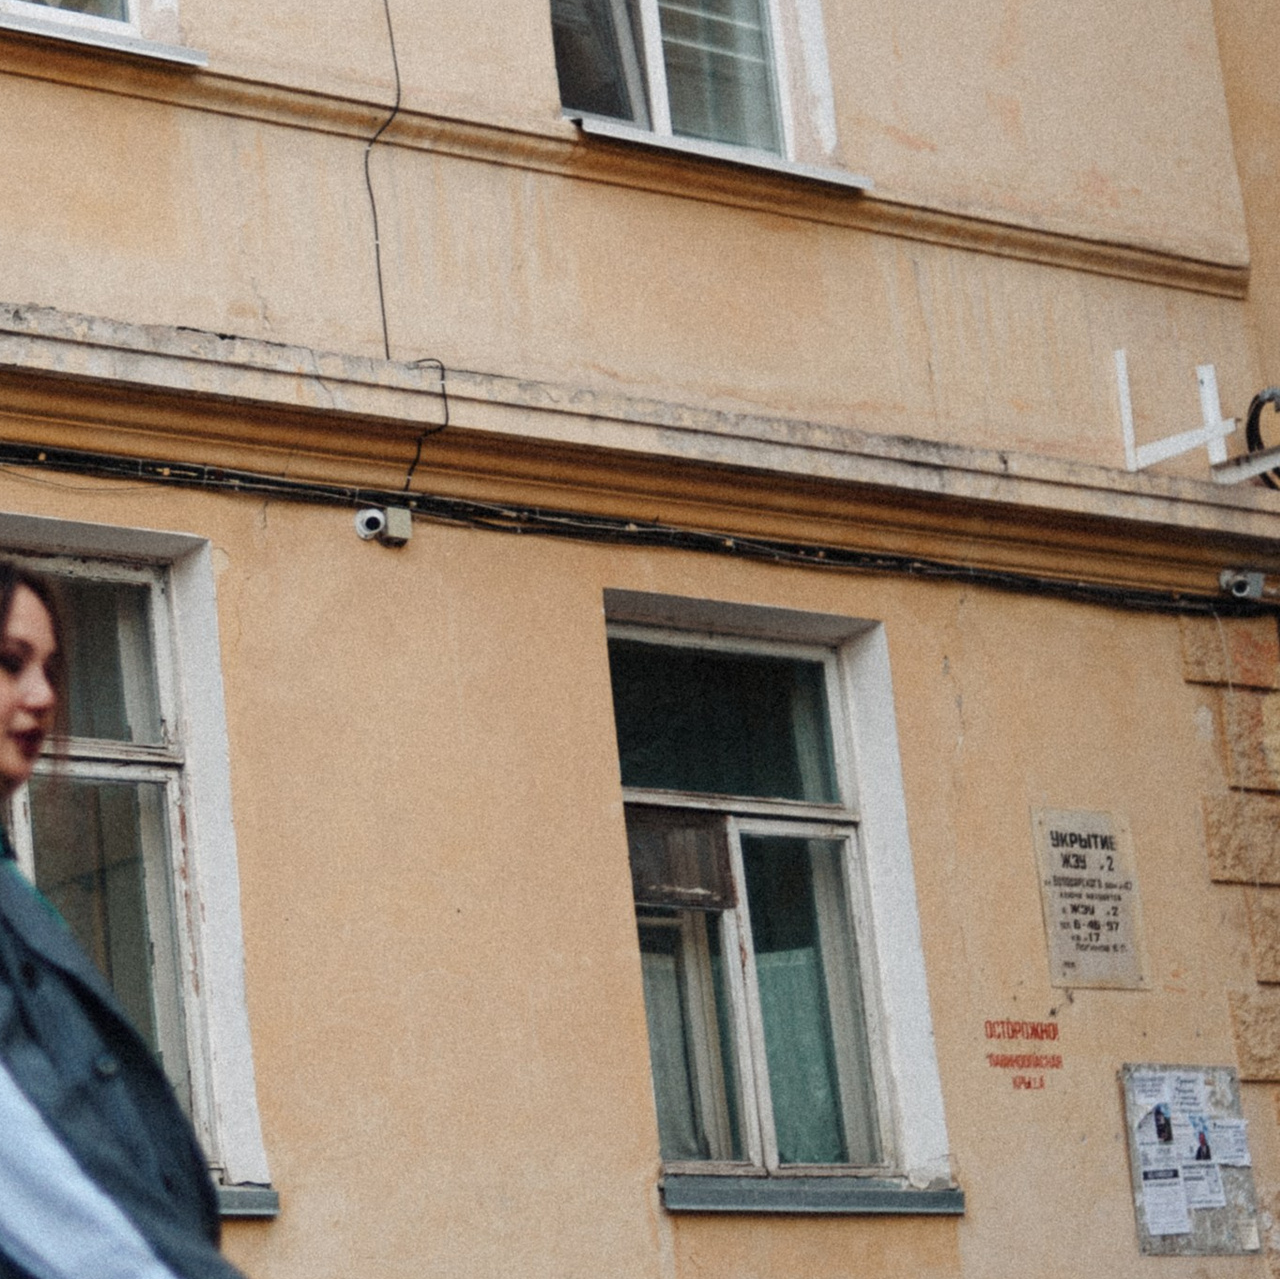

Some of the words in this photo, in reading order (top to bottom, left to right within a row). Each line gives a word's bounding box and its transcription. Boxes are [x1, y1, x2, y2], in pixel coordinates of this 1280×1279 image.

[1049, 830, 1116, 851] УКРЫТИЕ
[1061, 853, 1087, 870] ЖЭУ
[1070, 904, 1095, 915] ЖЭУ
